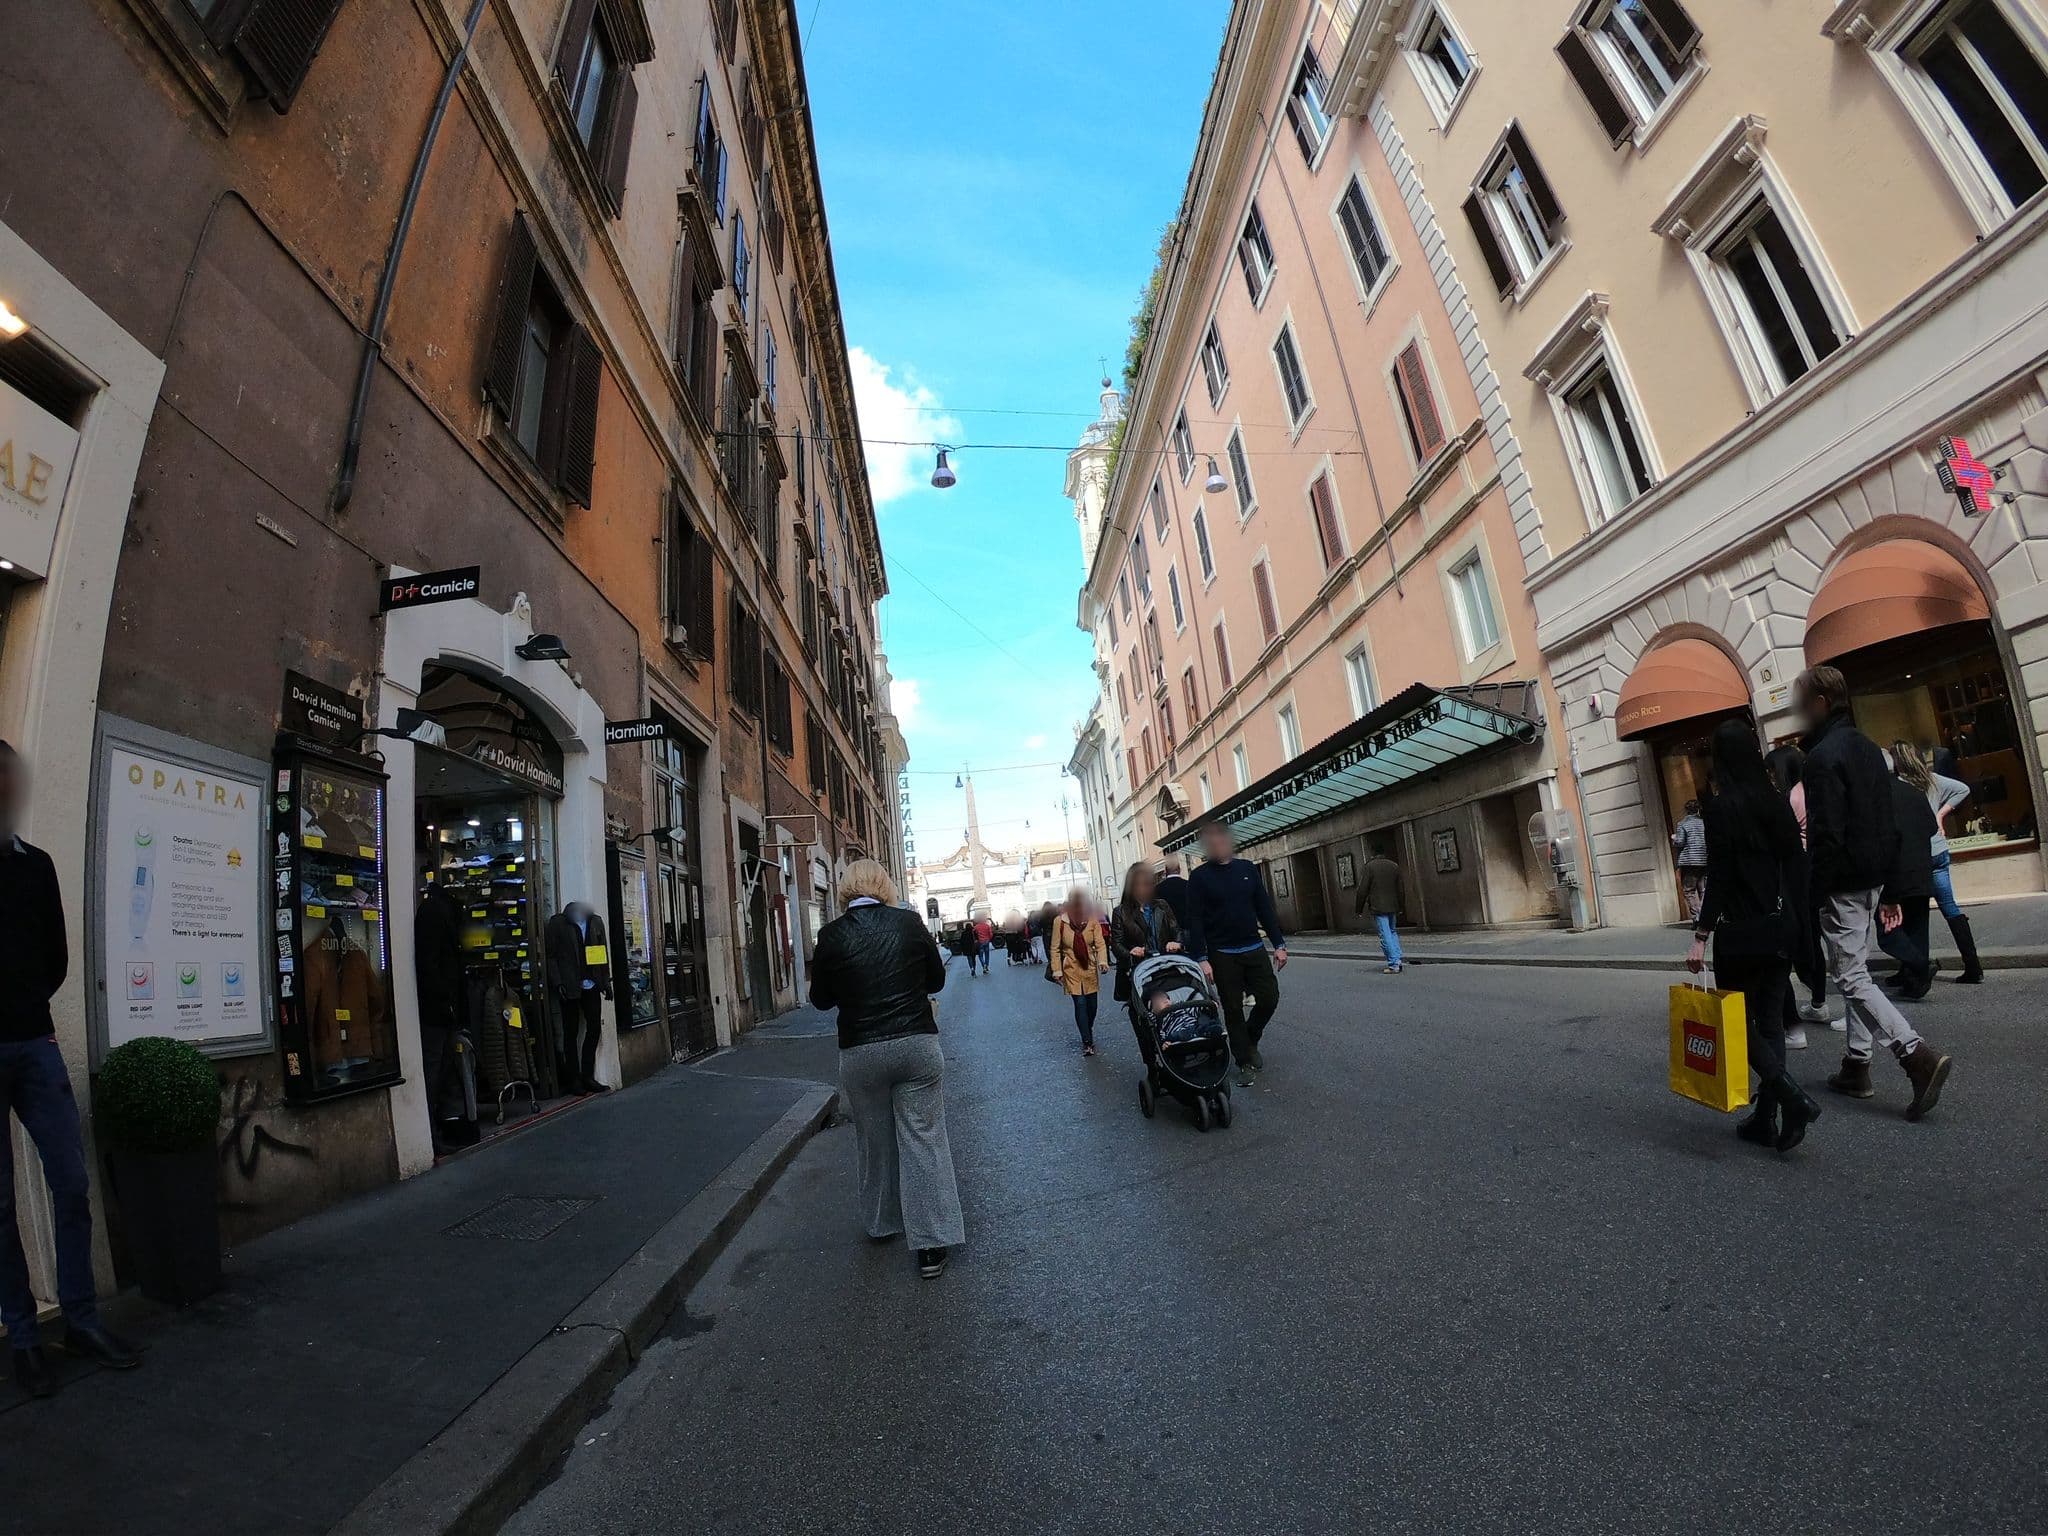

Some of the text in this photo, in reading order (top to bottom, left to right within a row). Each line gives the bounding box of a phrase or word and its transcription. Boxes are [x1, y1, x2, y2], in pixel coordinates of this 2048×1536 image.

[421, 579, 475, 597] Camicie
[1760, 669, 1772, 684] 10
[292, 686, 357, 722] David Hamilton
[308, 709, 341, 731] Camicie
[606, 723, 663, 740] Hamilton
[496, 749, 526, 774] David
[527, 761, 562, 790] Hamilton
[128, 763, 245, 810] OPATRA
[172, 929, 191, 937] There's
[198, 930, 209, 939] light
[321, 937, 338, 951] sun
[1687, 1036, 1714, 1059] LEGO
